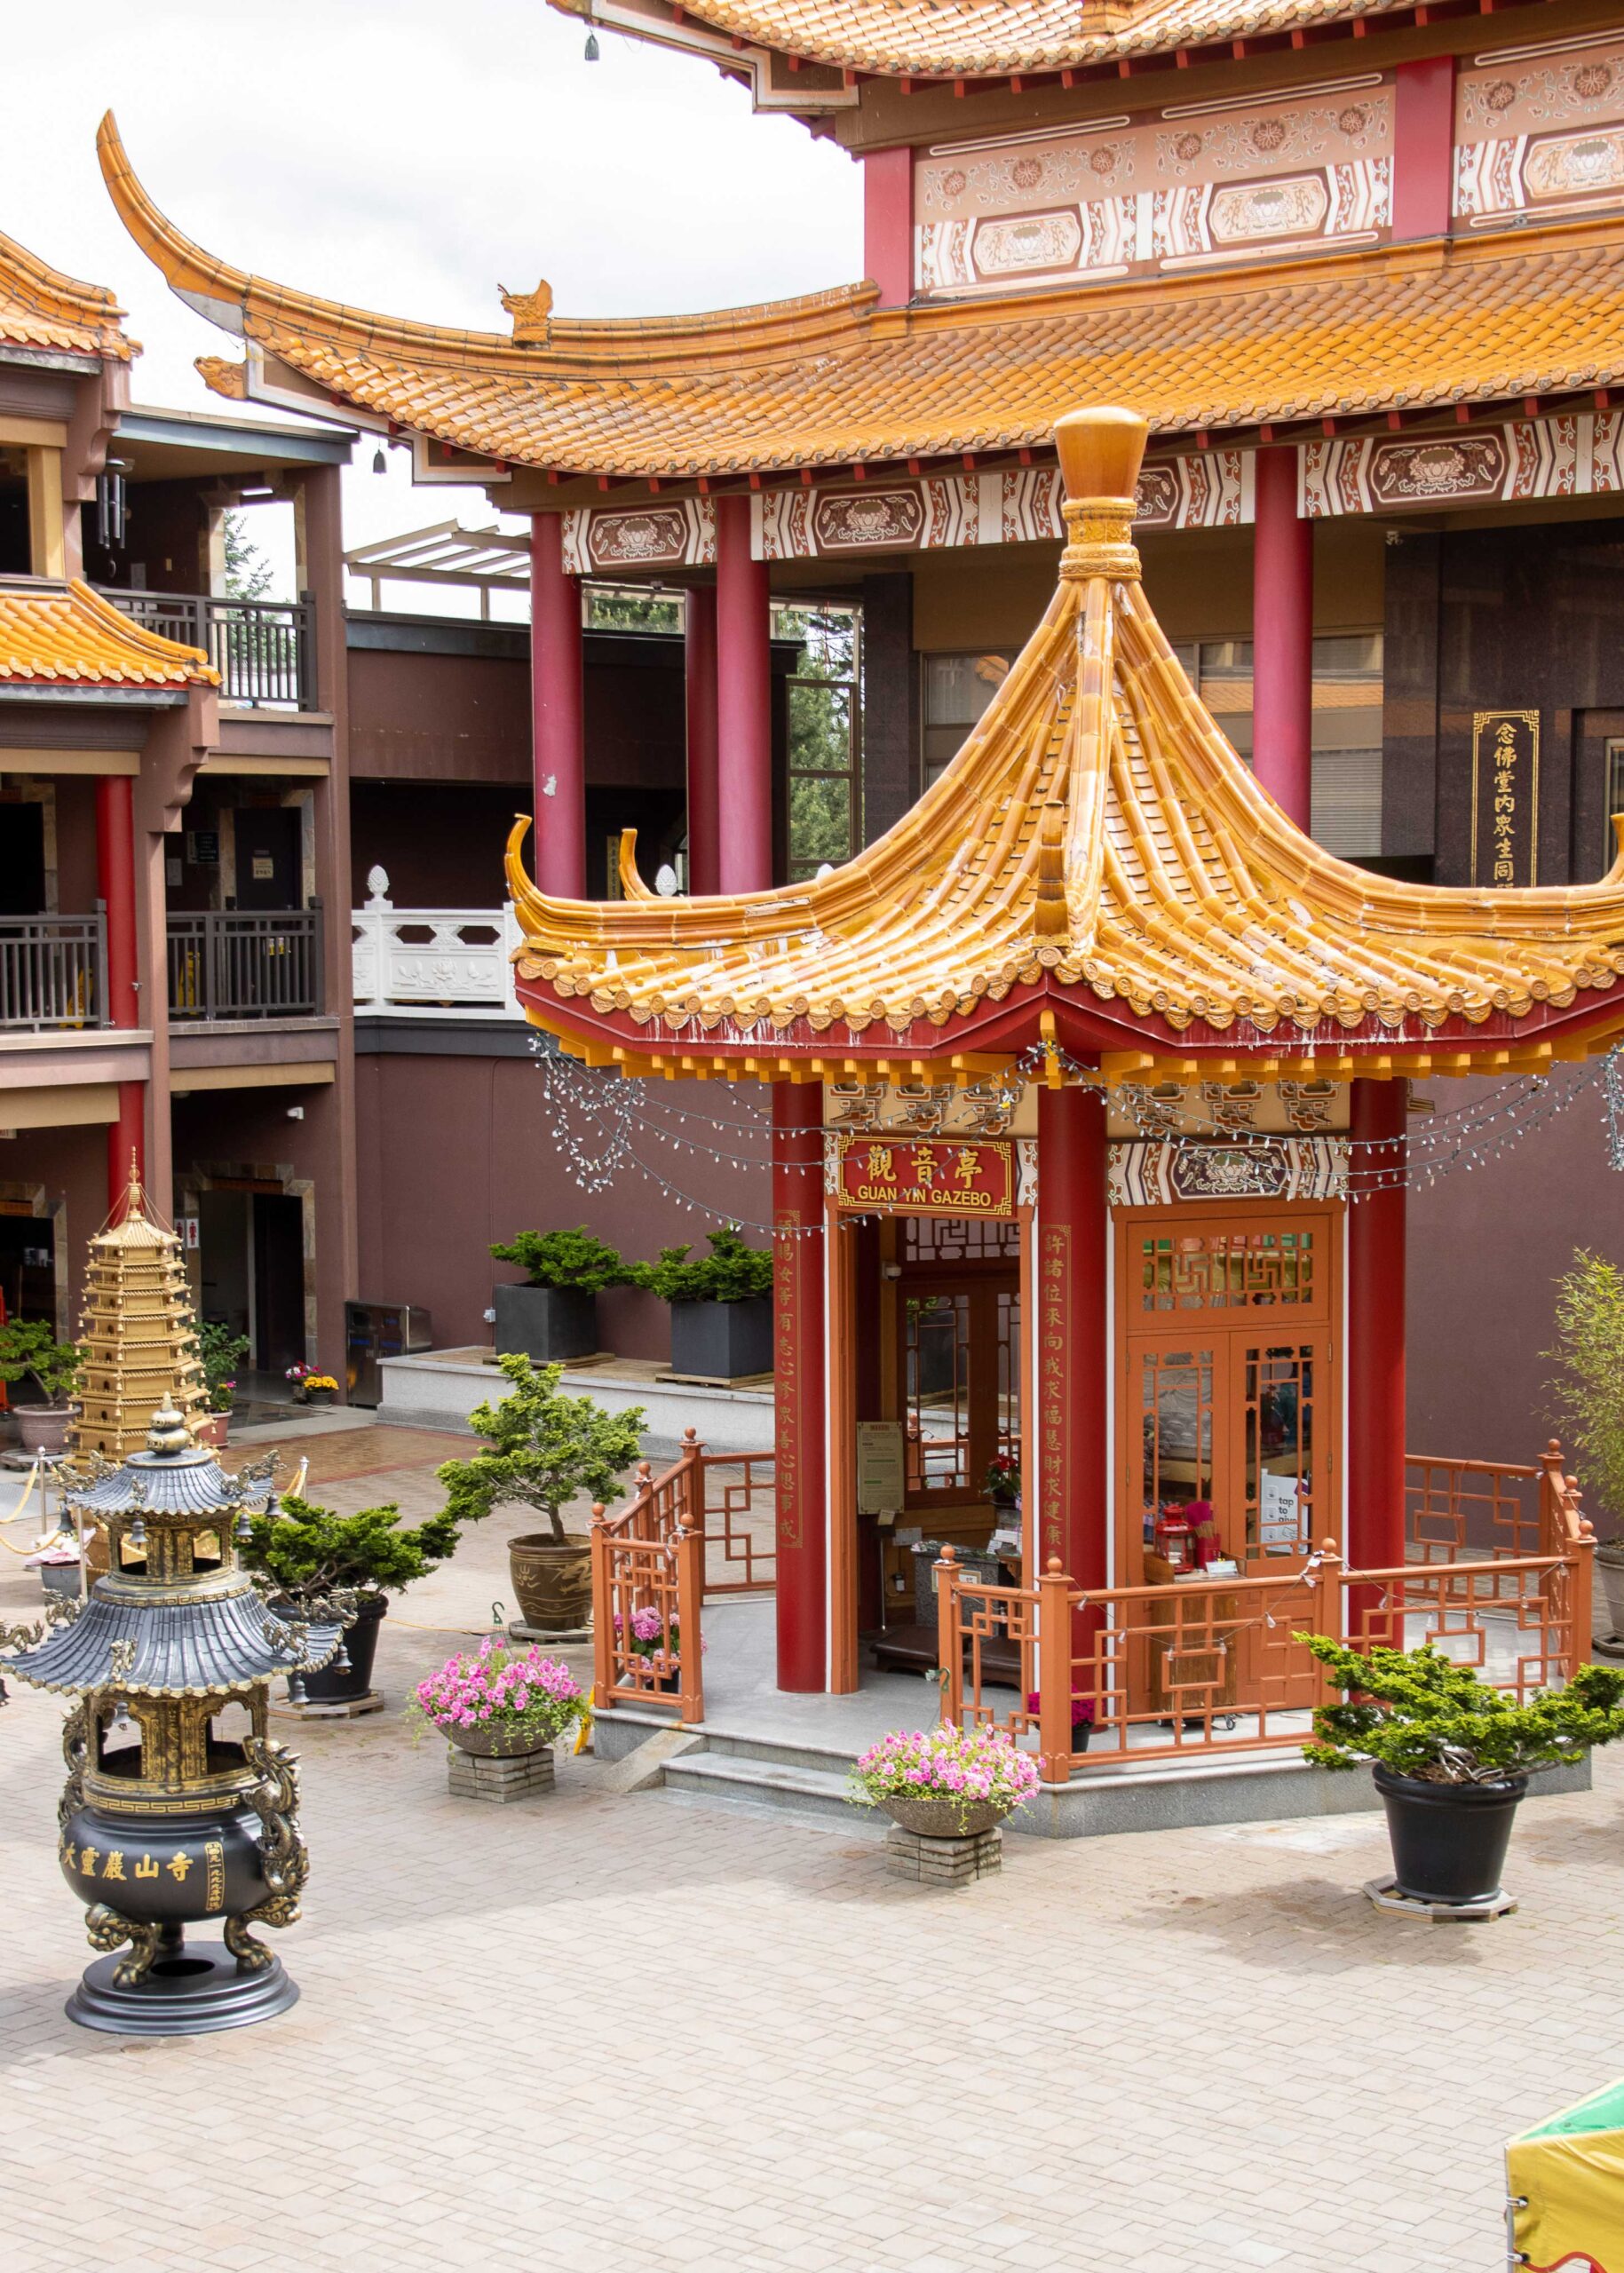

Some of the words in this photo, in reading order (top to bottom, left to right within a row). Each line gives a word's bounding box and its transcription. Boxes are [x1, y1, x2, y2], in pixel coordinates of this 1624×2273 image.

[866, 1144, 982, 1189] 觀音亭
[858, 1185, 898, 1201] GUAN
[903, 1188, 926, 1203] YIN
[931, 1190, 992, 1207] GAZEBO
[1279, 1497, 1295, 1508] tap
